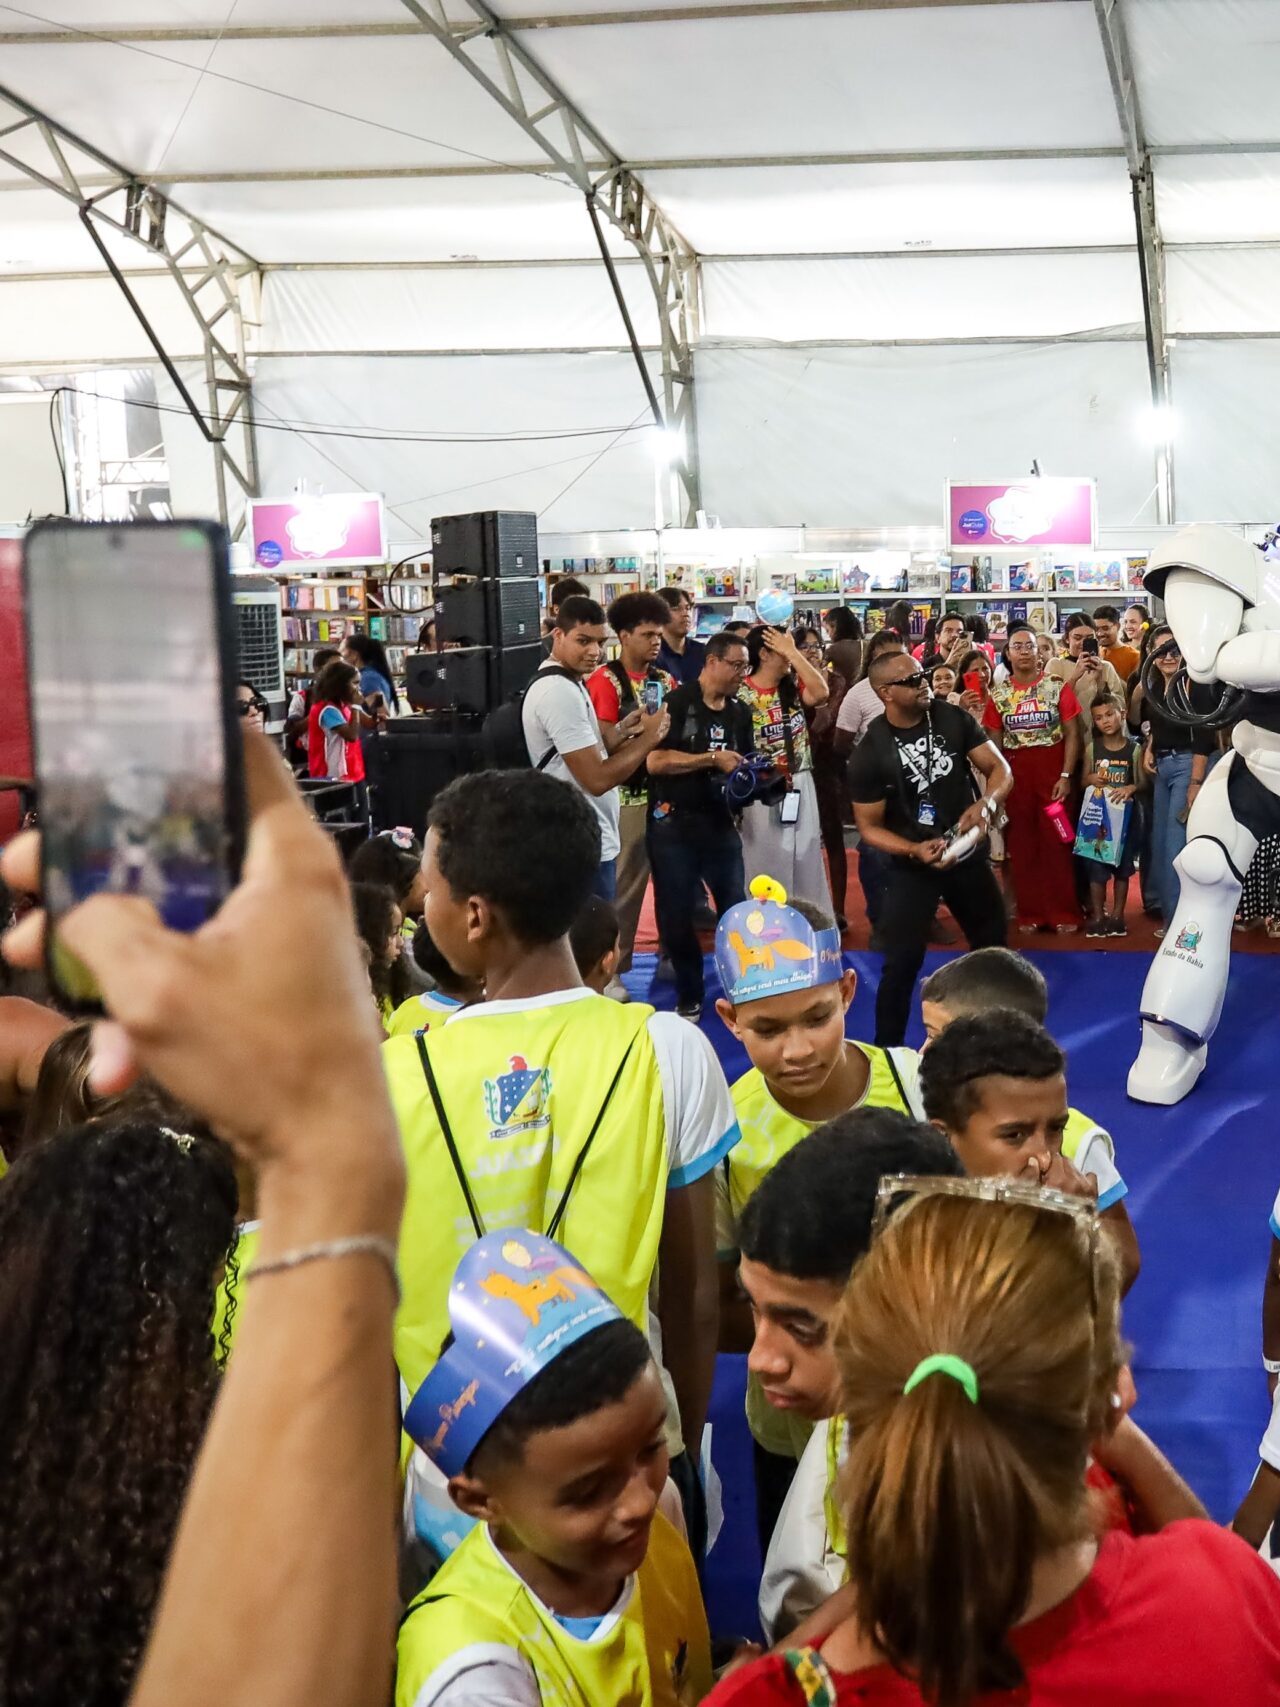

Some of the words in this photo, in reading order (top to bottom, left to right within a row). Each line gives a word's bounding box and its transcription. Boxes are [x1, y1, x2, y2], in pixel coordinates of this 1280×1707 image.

[1162, 947, 1178, 958] Estado
[1178, 952, 1186, 961] da
[1186, 955, 1204, 969] Bahia
